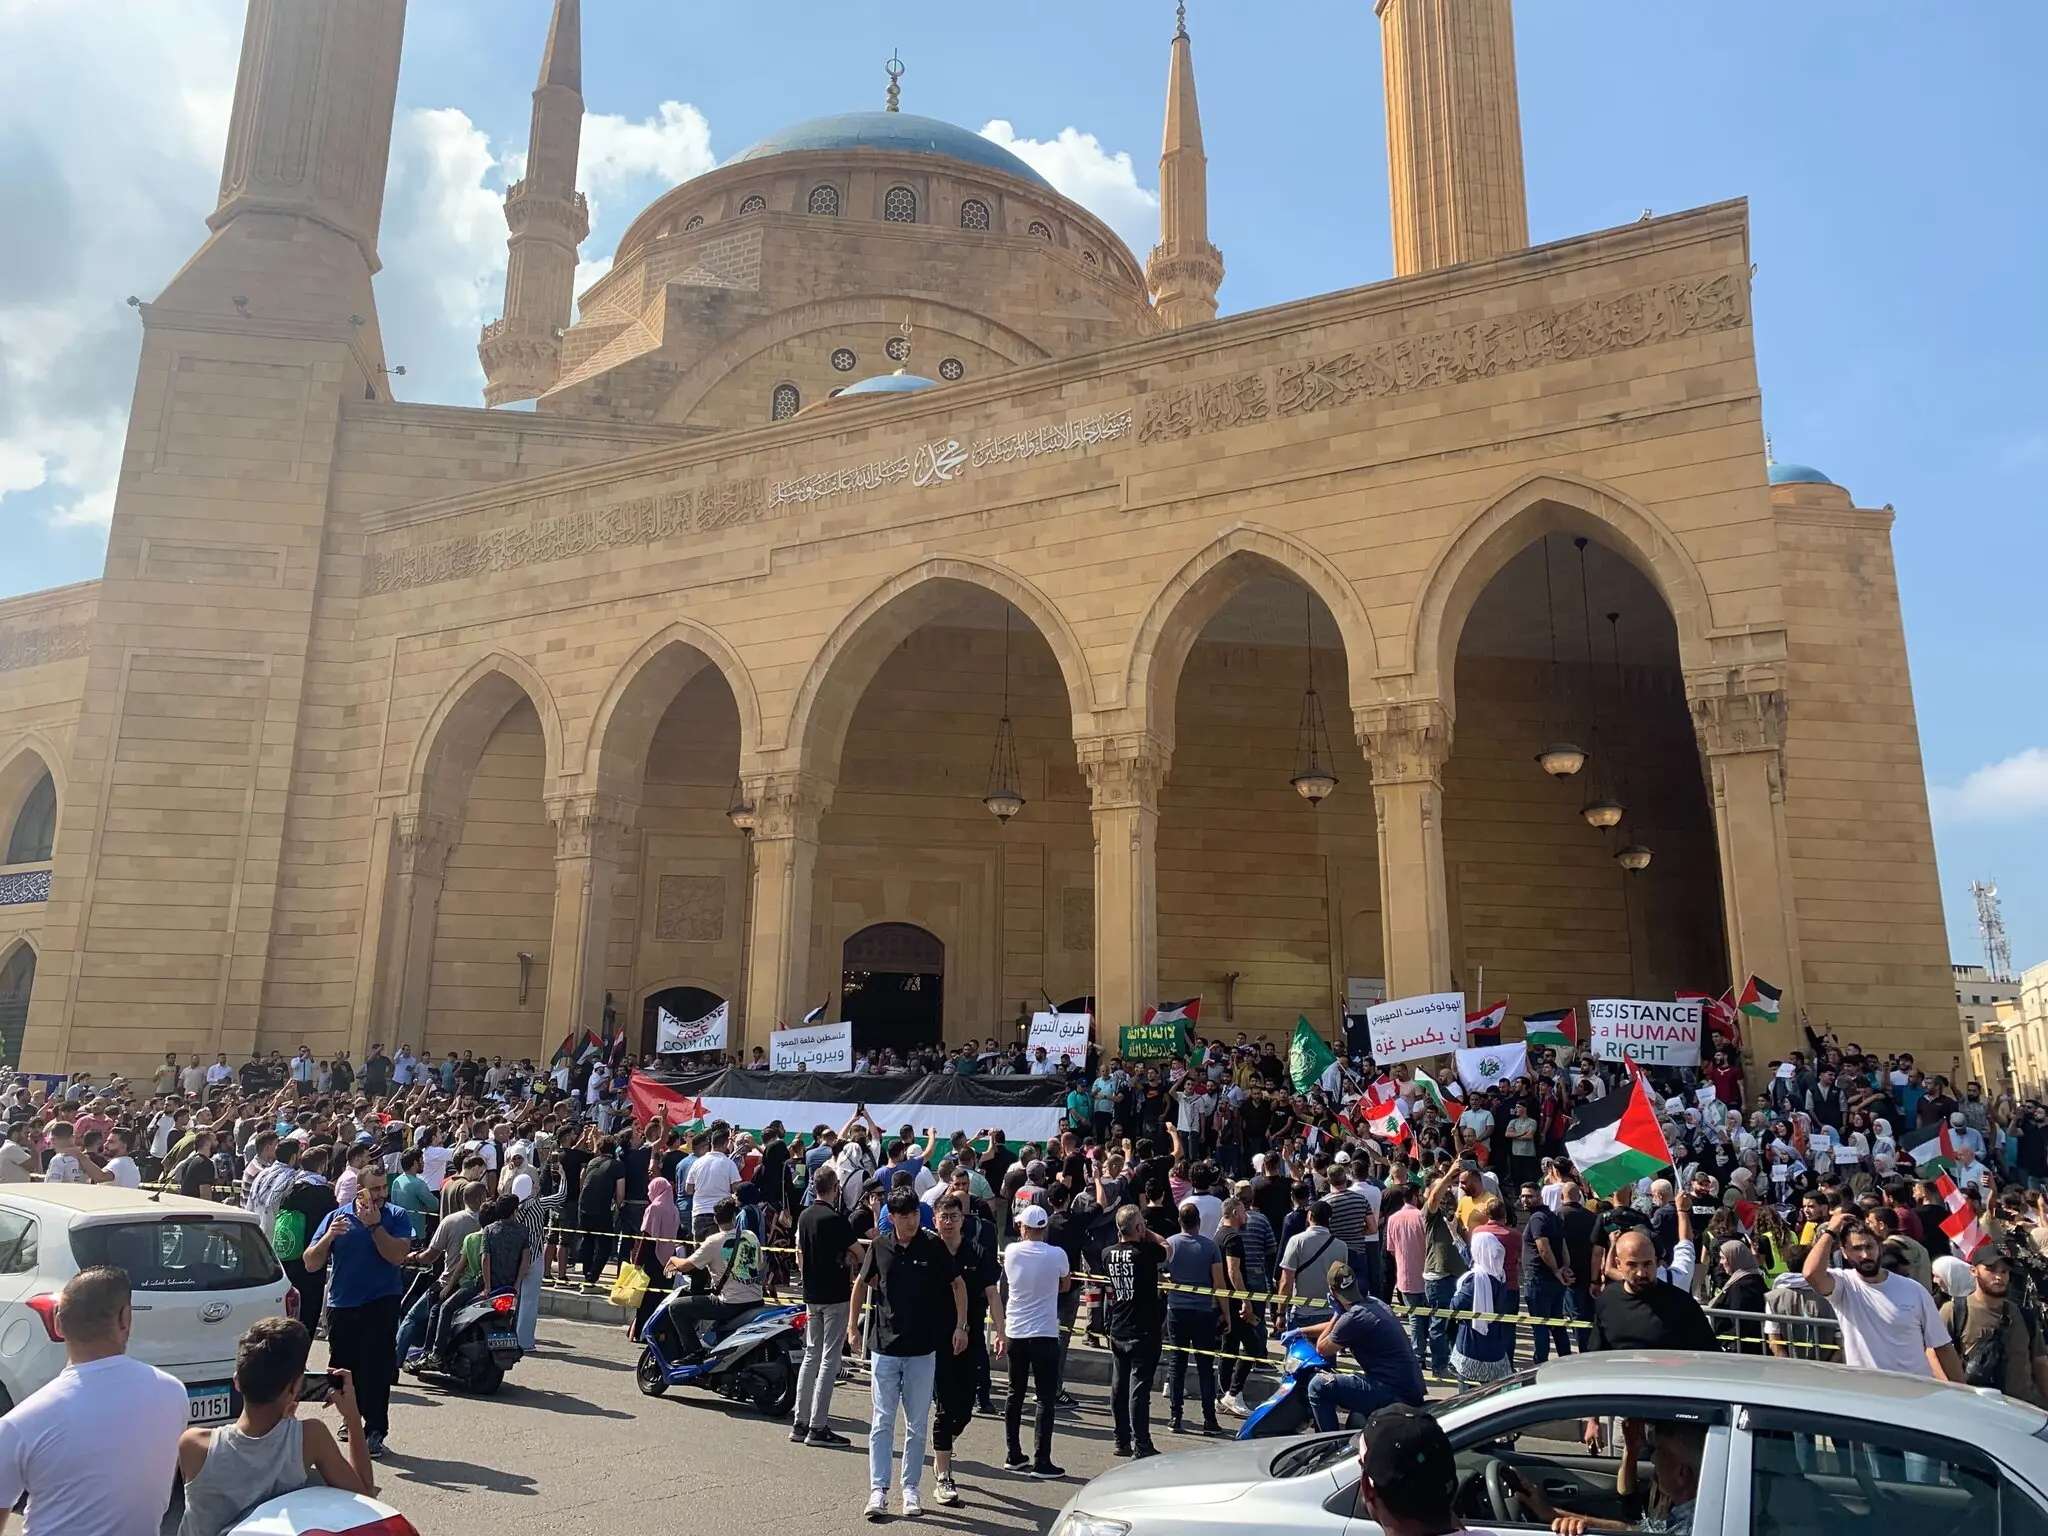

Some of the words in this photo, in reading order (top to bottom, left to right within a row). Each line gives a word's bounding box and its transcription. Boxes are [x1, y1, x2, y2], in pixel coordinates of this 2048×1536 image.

[1591, 1003, 1698, 1023] RESISTANCE
[677, 1024, 709, 1040] FREE
[1031, 1020, 1060, 1036] التحرير
[1059, 1020, 1085, 1038] طريق
[1590, 1025, 1597, 1037] s
[1600, 1025, 1610, 1037] a
[1615, 1022, 1697, 1042] HUMAN
[663, 1034, 721, 1052] COUNTRY
[776, 1038, 799, 1048] الصمود
[800, 1035, 815, 1044] قلعة
[816, 1031, 846, 1044] فلسطين
[1401, 1026, 1444, 1053] يكسر
[803, 1049, 845, 1064] وبيروت
[1062, 1044, 1087, 1057] الجهاد
[1606, 1042, 1669, 1061] RIGHT
[1110, 1250, 1133, 1263] THE
[1108, 1263, 1135, 1276] BEST
[1111, 1277, 1134, 1289] WAY
[190, 1397, 228, 1418] 01151
